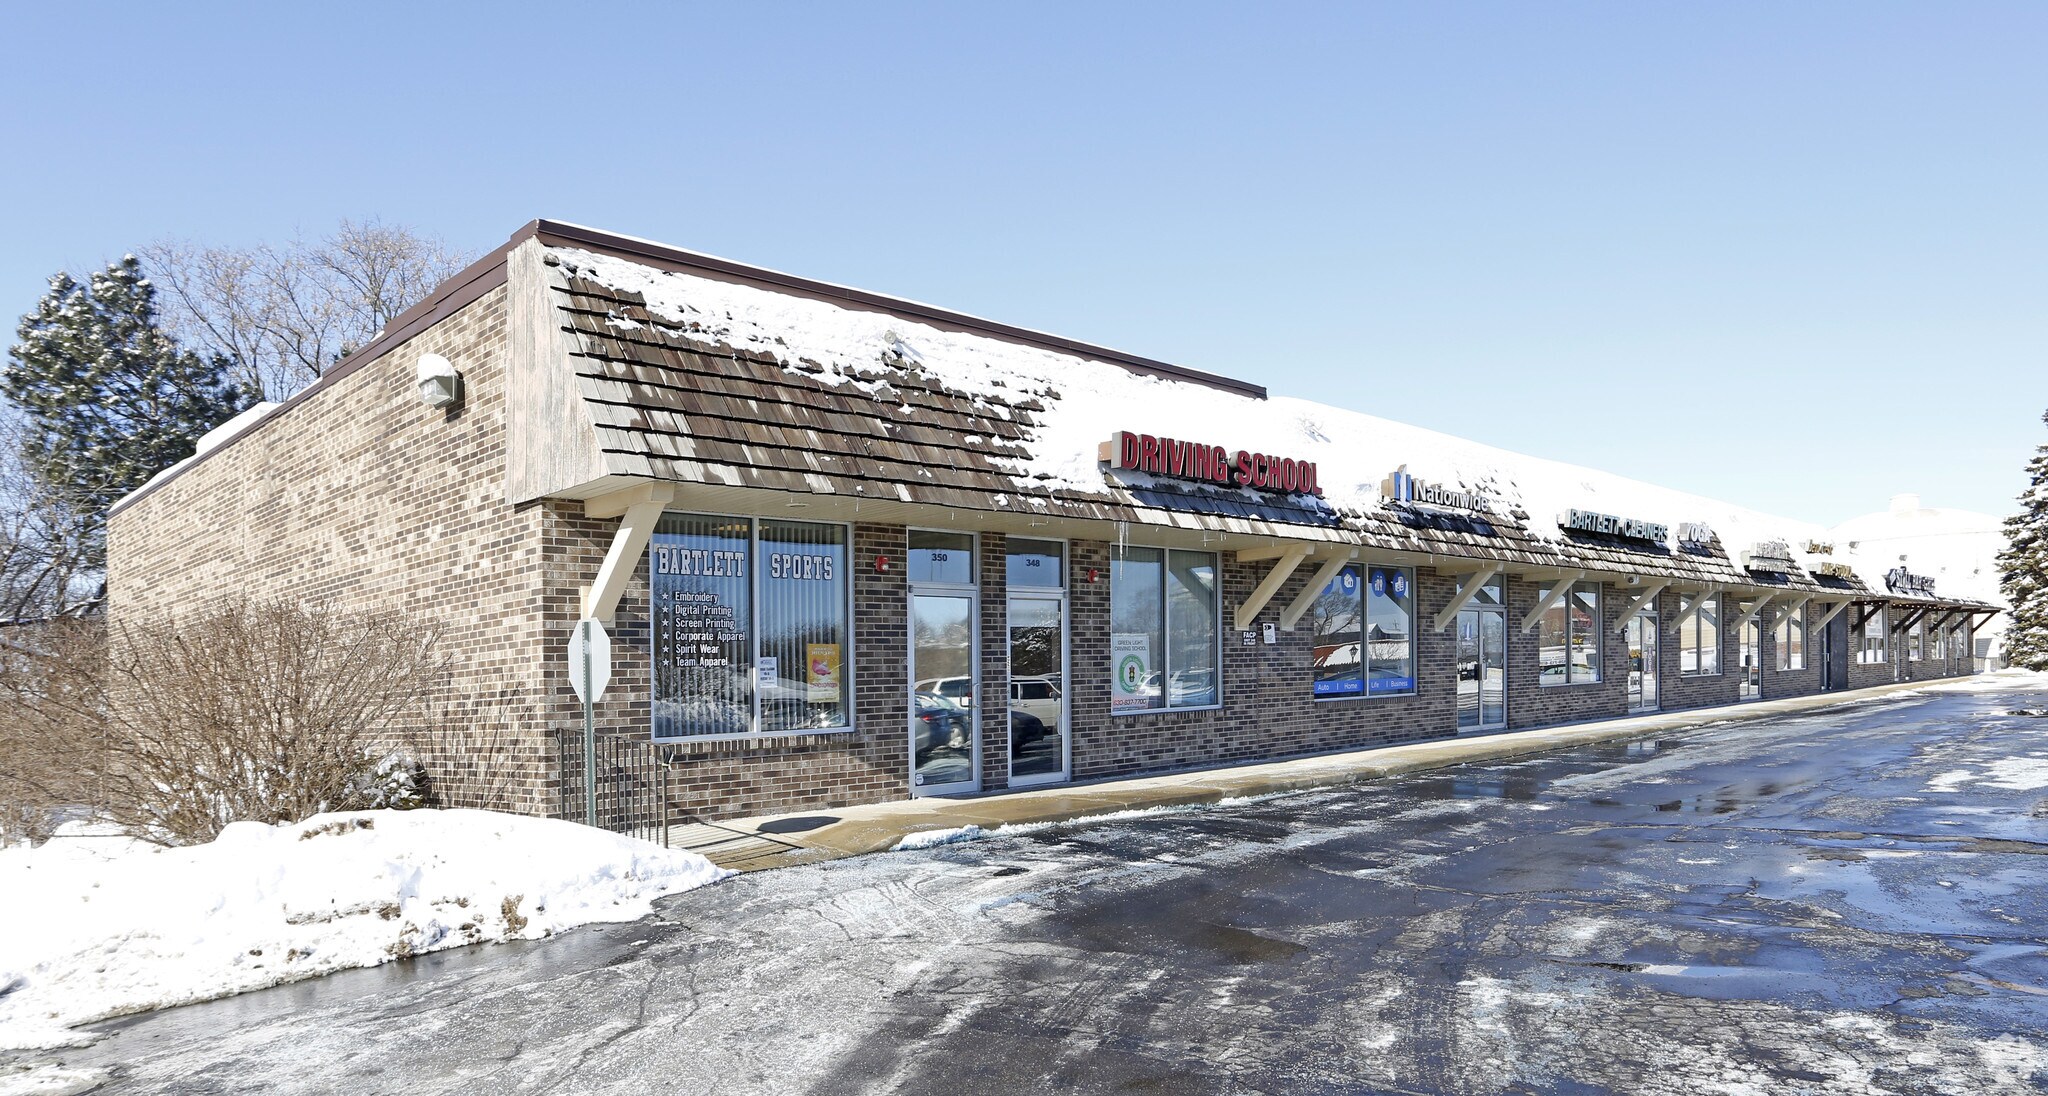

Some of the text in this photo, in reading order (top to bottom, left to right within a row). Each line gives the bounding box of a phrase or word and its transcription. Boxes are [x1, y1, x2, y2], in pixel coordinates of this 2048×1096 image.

[1121, 431, 1323, 495] DRIVING SCHOOL
[1415, 478, 1489, 512] Nationwide
[1570, 508, 1669, 542] BARTLETT CLEANERS
[657, 548, 834, 580] BARTLETT SPORTS
[931, 553, 948, 562] 350
[1026, 559, 1040, 567] 348
[675, 591, 719, 604] Embroidery
[675, 604, 732, 617] Digital Printing
[675, 618, 735, 630] Screen Printing
[675, 630, 746, 643] Corporate Apparel
[675, 644, 720, 656] Spirit Wear
[675, 656, 728, 668] Team Apparel
[1390, 680, 1409, 688] Business
